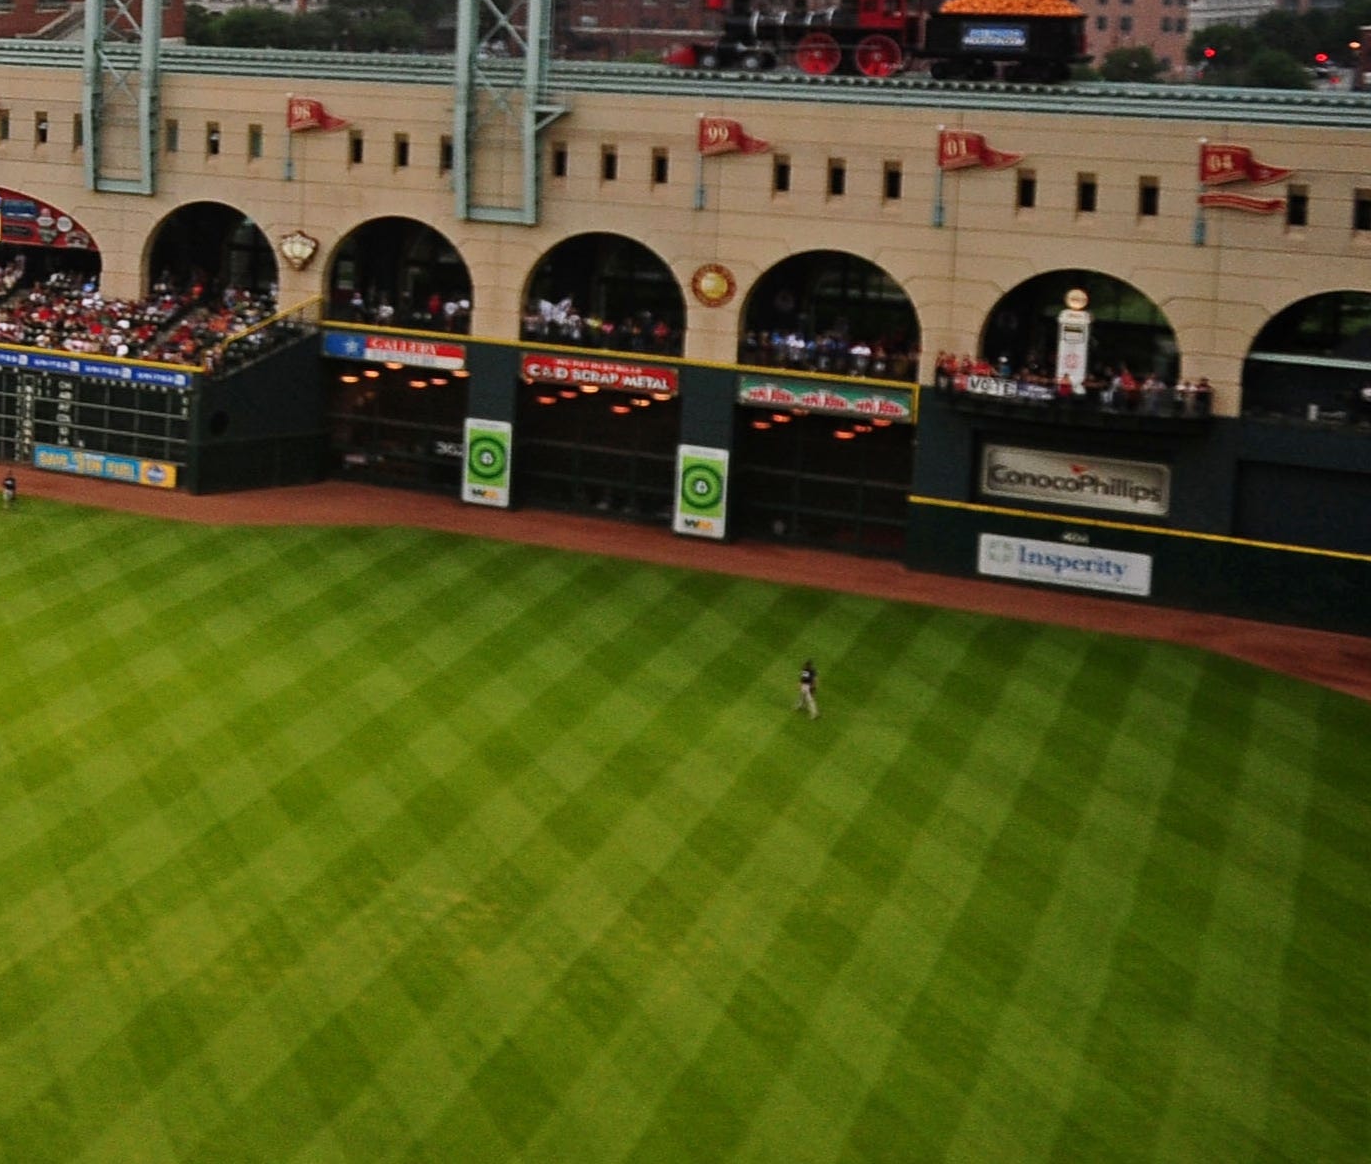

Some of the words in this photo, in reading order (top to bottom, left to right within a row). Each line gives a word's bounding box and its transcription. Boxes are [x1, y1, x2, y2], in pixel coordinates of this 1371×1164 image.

[708, 127, 729, 142] 99
[946, 139, 967, 155] 01
[572, 369, 619, 384] SCRAP
[622, 374, 669, 391] METAL
[989, 463, 1163, 504] ConocoPhillips
[1018, 544, 1128, 582] Insperity
